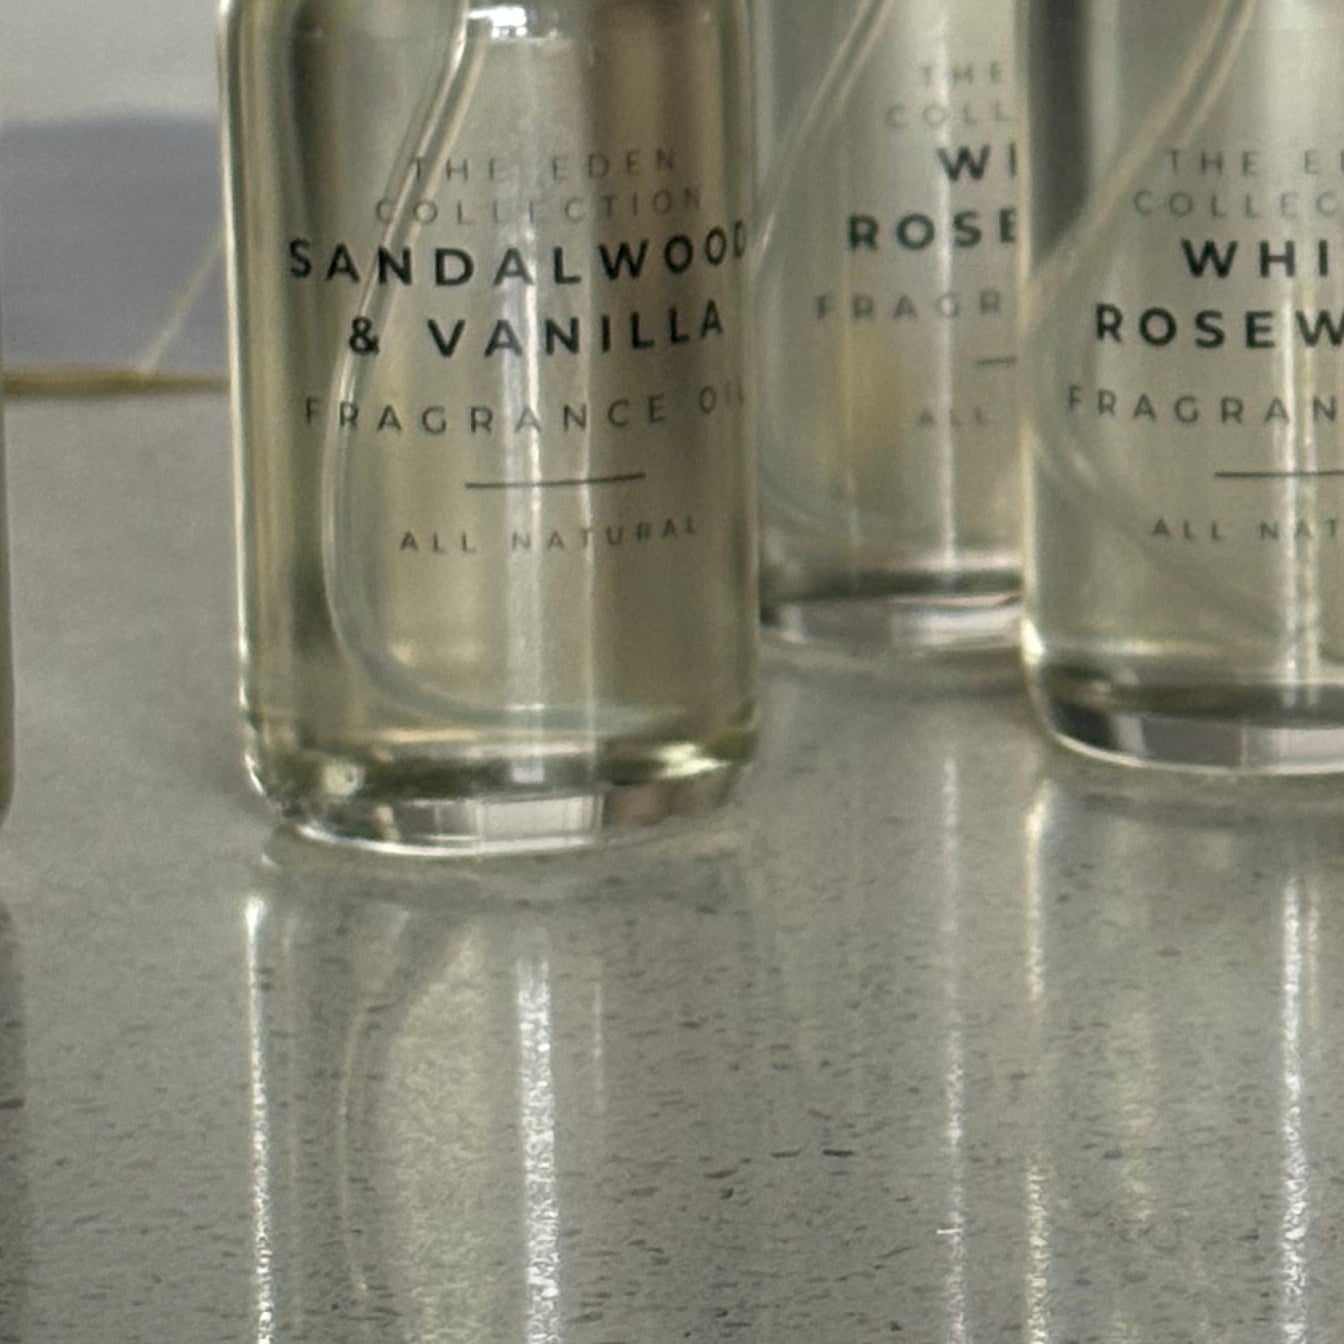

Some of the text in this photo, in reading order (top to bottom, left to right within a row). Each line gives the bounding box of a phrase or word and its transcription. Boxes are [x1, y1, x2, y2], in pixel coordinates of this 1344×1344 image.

[409, 147, 676, 184] THE EDEN
[1166, 149, 1266, 177] THE
[374, 187, 699, 225] COLLECTION
[288, 220, 747, 287] SANDALWOOD
[348, 299, 725, 358] & VANILLA
[305, 392, 668, 436] FRAGRANCE
[399, 516, 698, 554] ALL NATURAL
[1151, 517, 1224, 541] ALL
